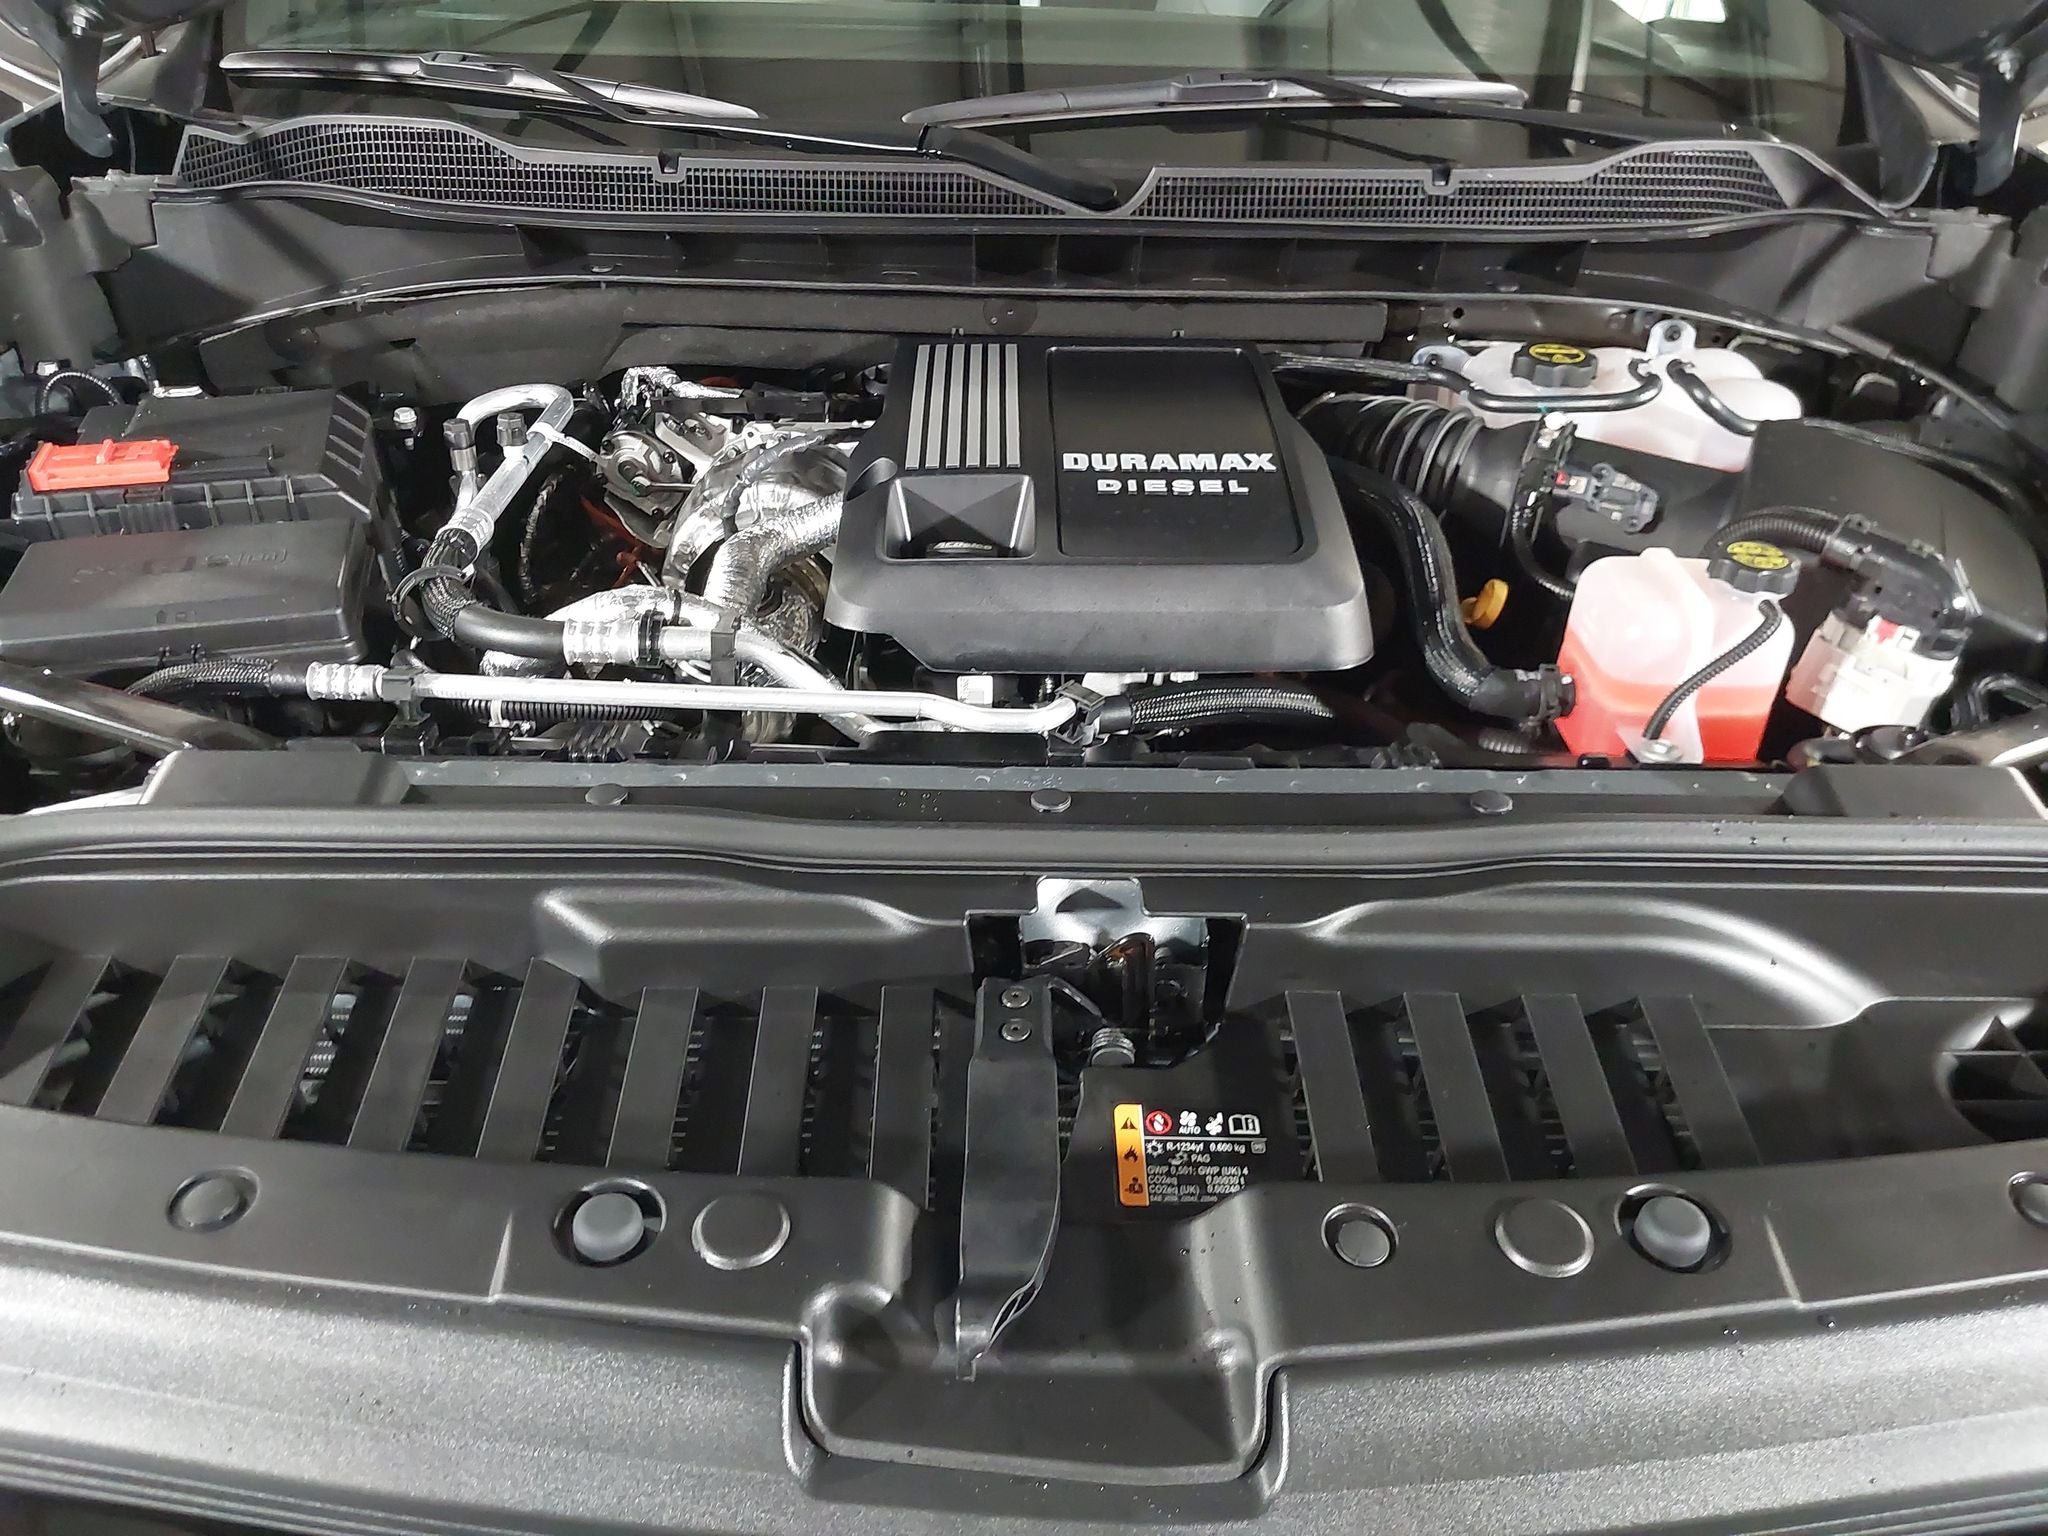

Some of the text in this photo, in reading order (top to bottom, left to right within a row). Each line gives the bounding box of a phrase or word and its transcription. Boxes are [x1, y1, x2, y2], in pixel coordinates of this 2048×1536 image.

[1062, 452, 1277, 472] DURAMAX
[1097, 479, 1250, 495] DIESEL
[1179, 1126, 1201, 1135] AUTO
[1166, 1141, 1204, 1153] R-1234yf
[1234, 1143, 1246, 1154] kg
[1191, 1153, 1211, 1163] PAG
[1147, 1165, 1169, 1175] GWP
[1197, 1165, 1220, 1175] GWP
[1221, 1166, 1241, 1177] (UK)
[1242, 1166, 1249, 1176] 4
[1179, 1184, 1200, 1195] (UK)
